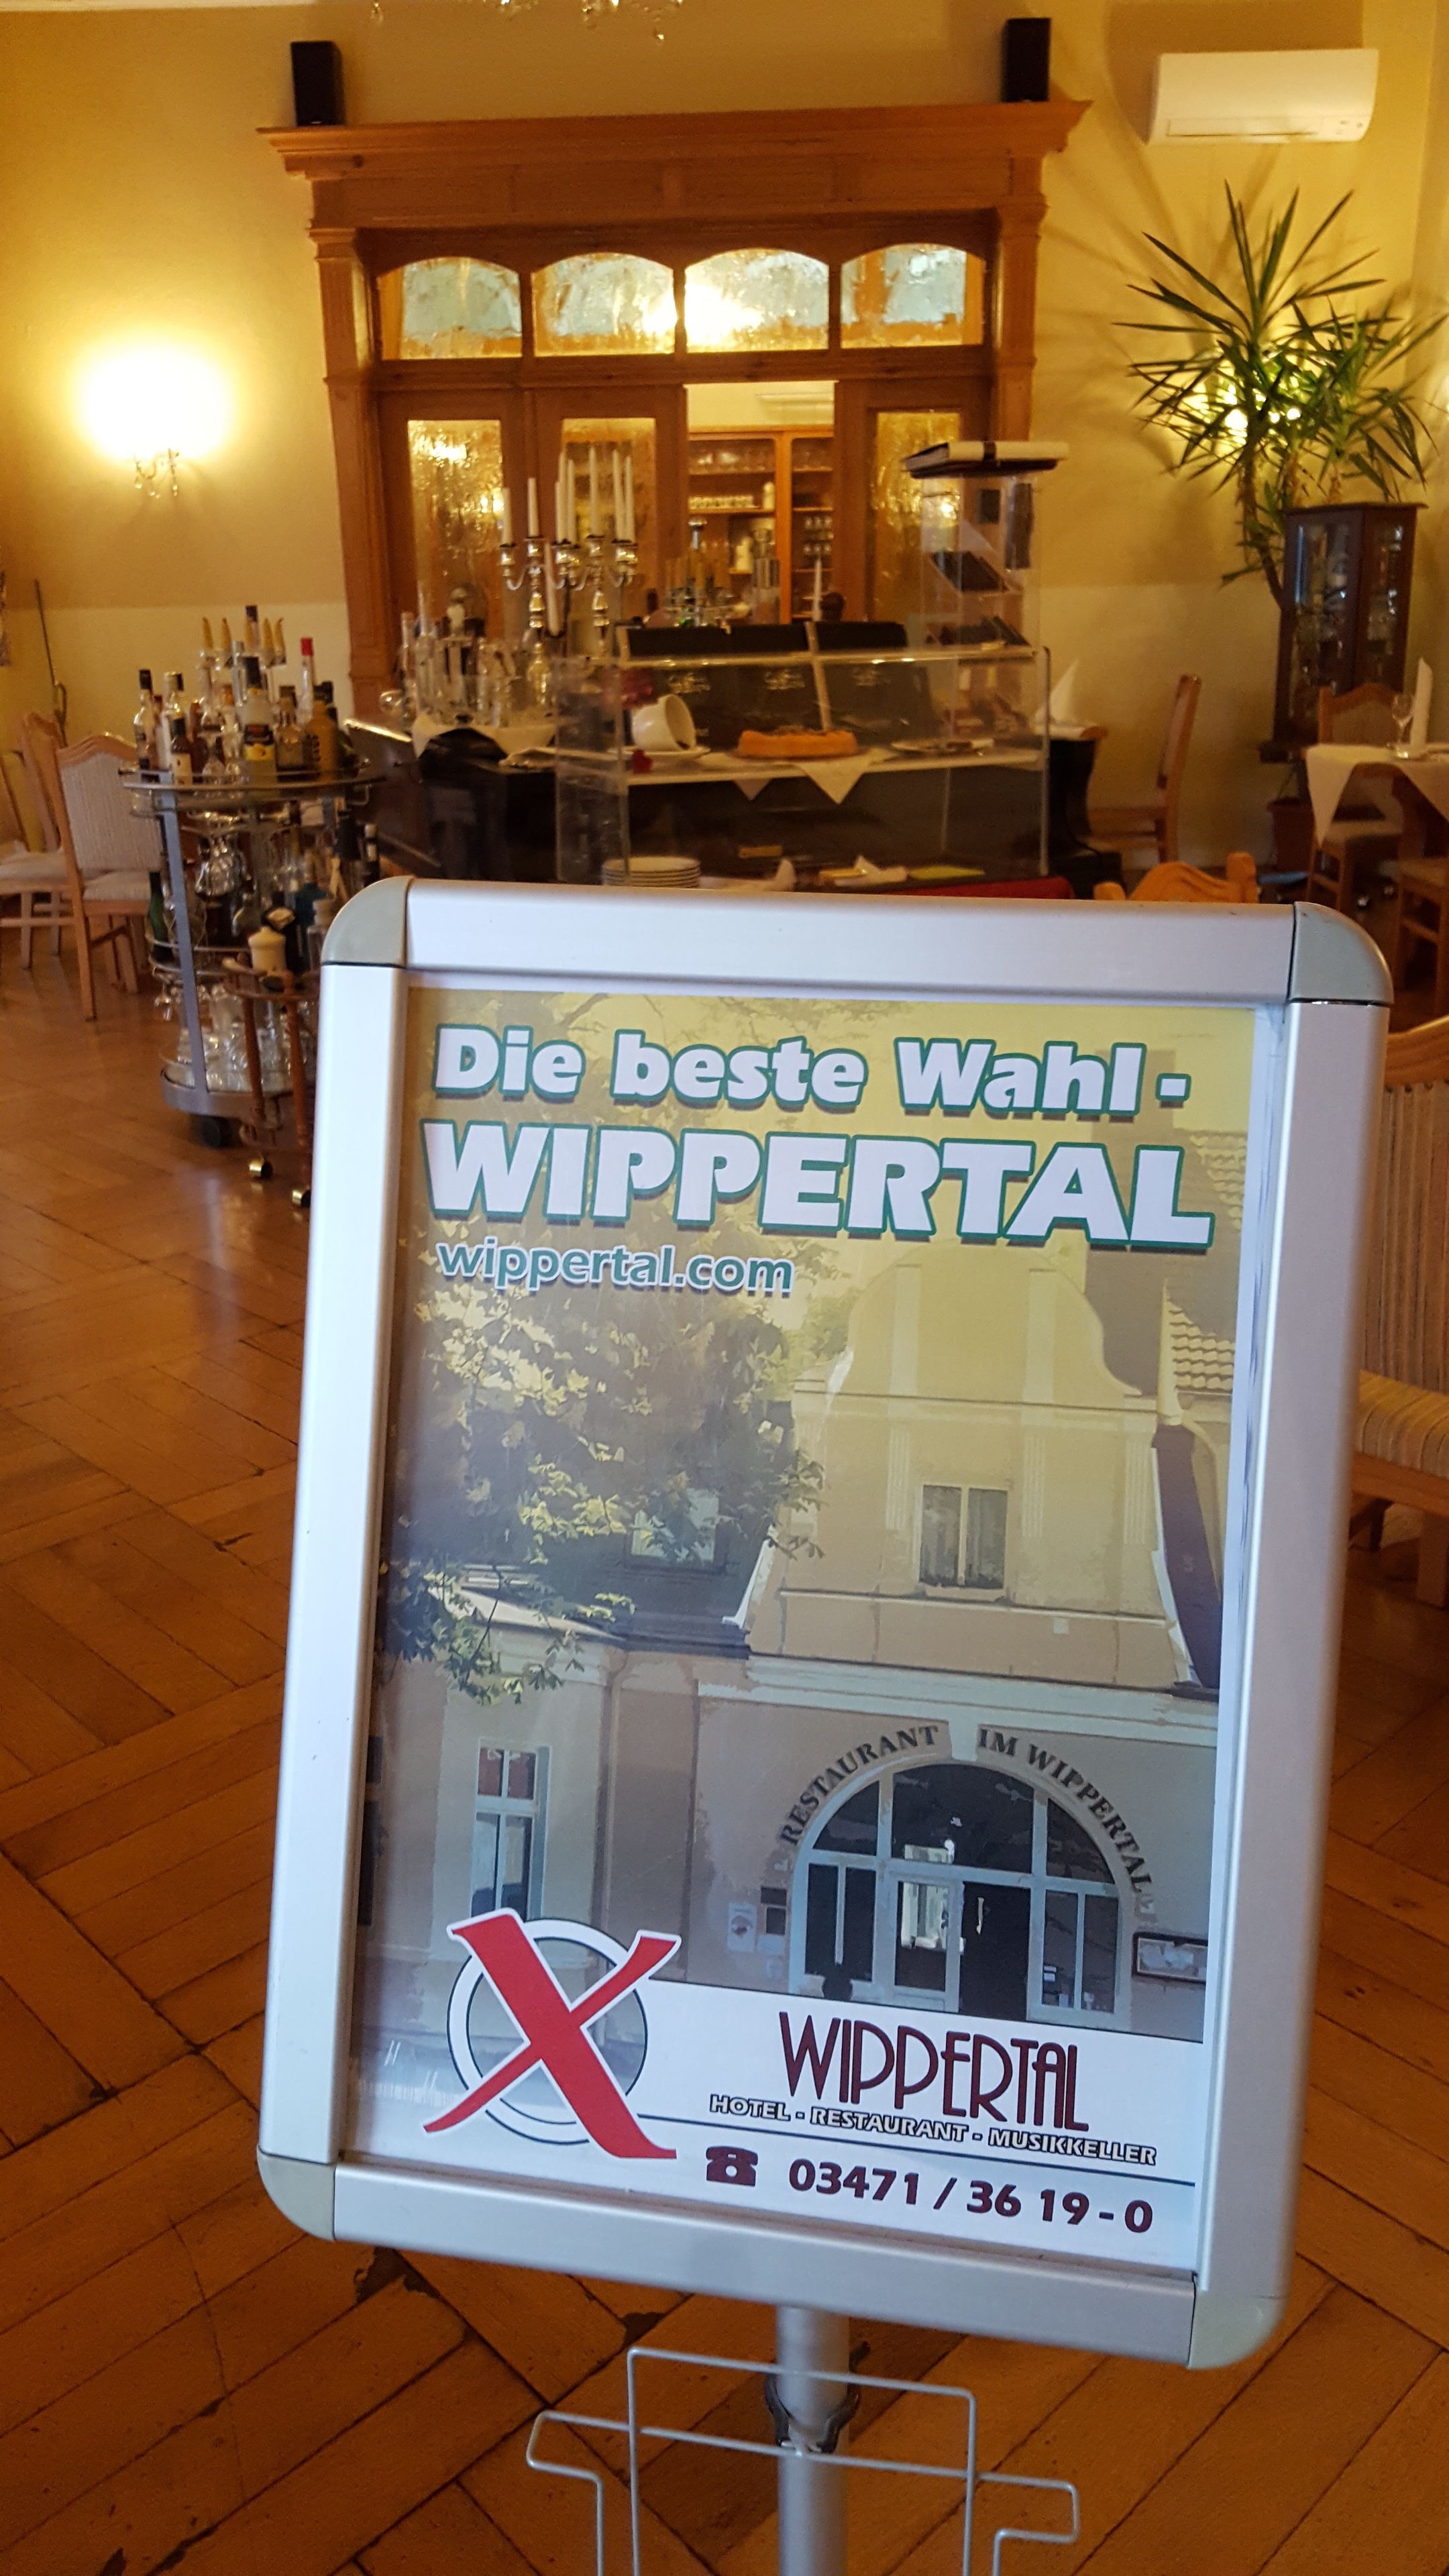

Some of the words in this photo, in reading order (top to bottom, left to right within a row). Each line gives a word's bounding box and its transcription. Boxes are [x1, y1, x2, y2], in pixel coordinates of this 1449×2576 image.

[434, 1024, 586, 1100] Die
[610, 1029, 869, 1110] beste
[894, 1037, 1146, 1117] Wahl
[421, 1118, 1215, 1249] WIPPERTAL
[436, 1237, 794, 1293] wippertal.com
[780, 1725, 939, 1846] RESTAURANT
[977, 1728, 1018, 1756] IM
[1027, 1743, 1152, 1893] WIPPERTAL
[780, 2012, 1089, 2131] WIPPERTAL
[710, 2094, 791, 2121] HOTEL
[810, 2106, 969, 2142] RESTAURANT
[988, 2127, 1157, 2165] MUSIKKELLER
